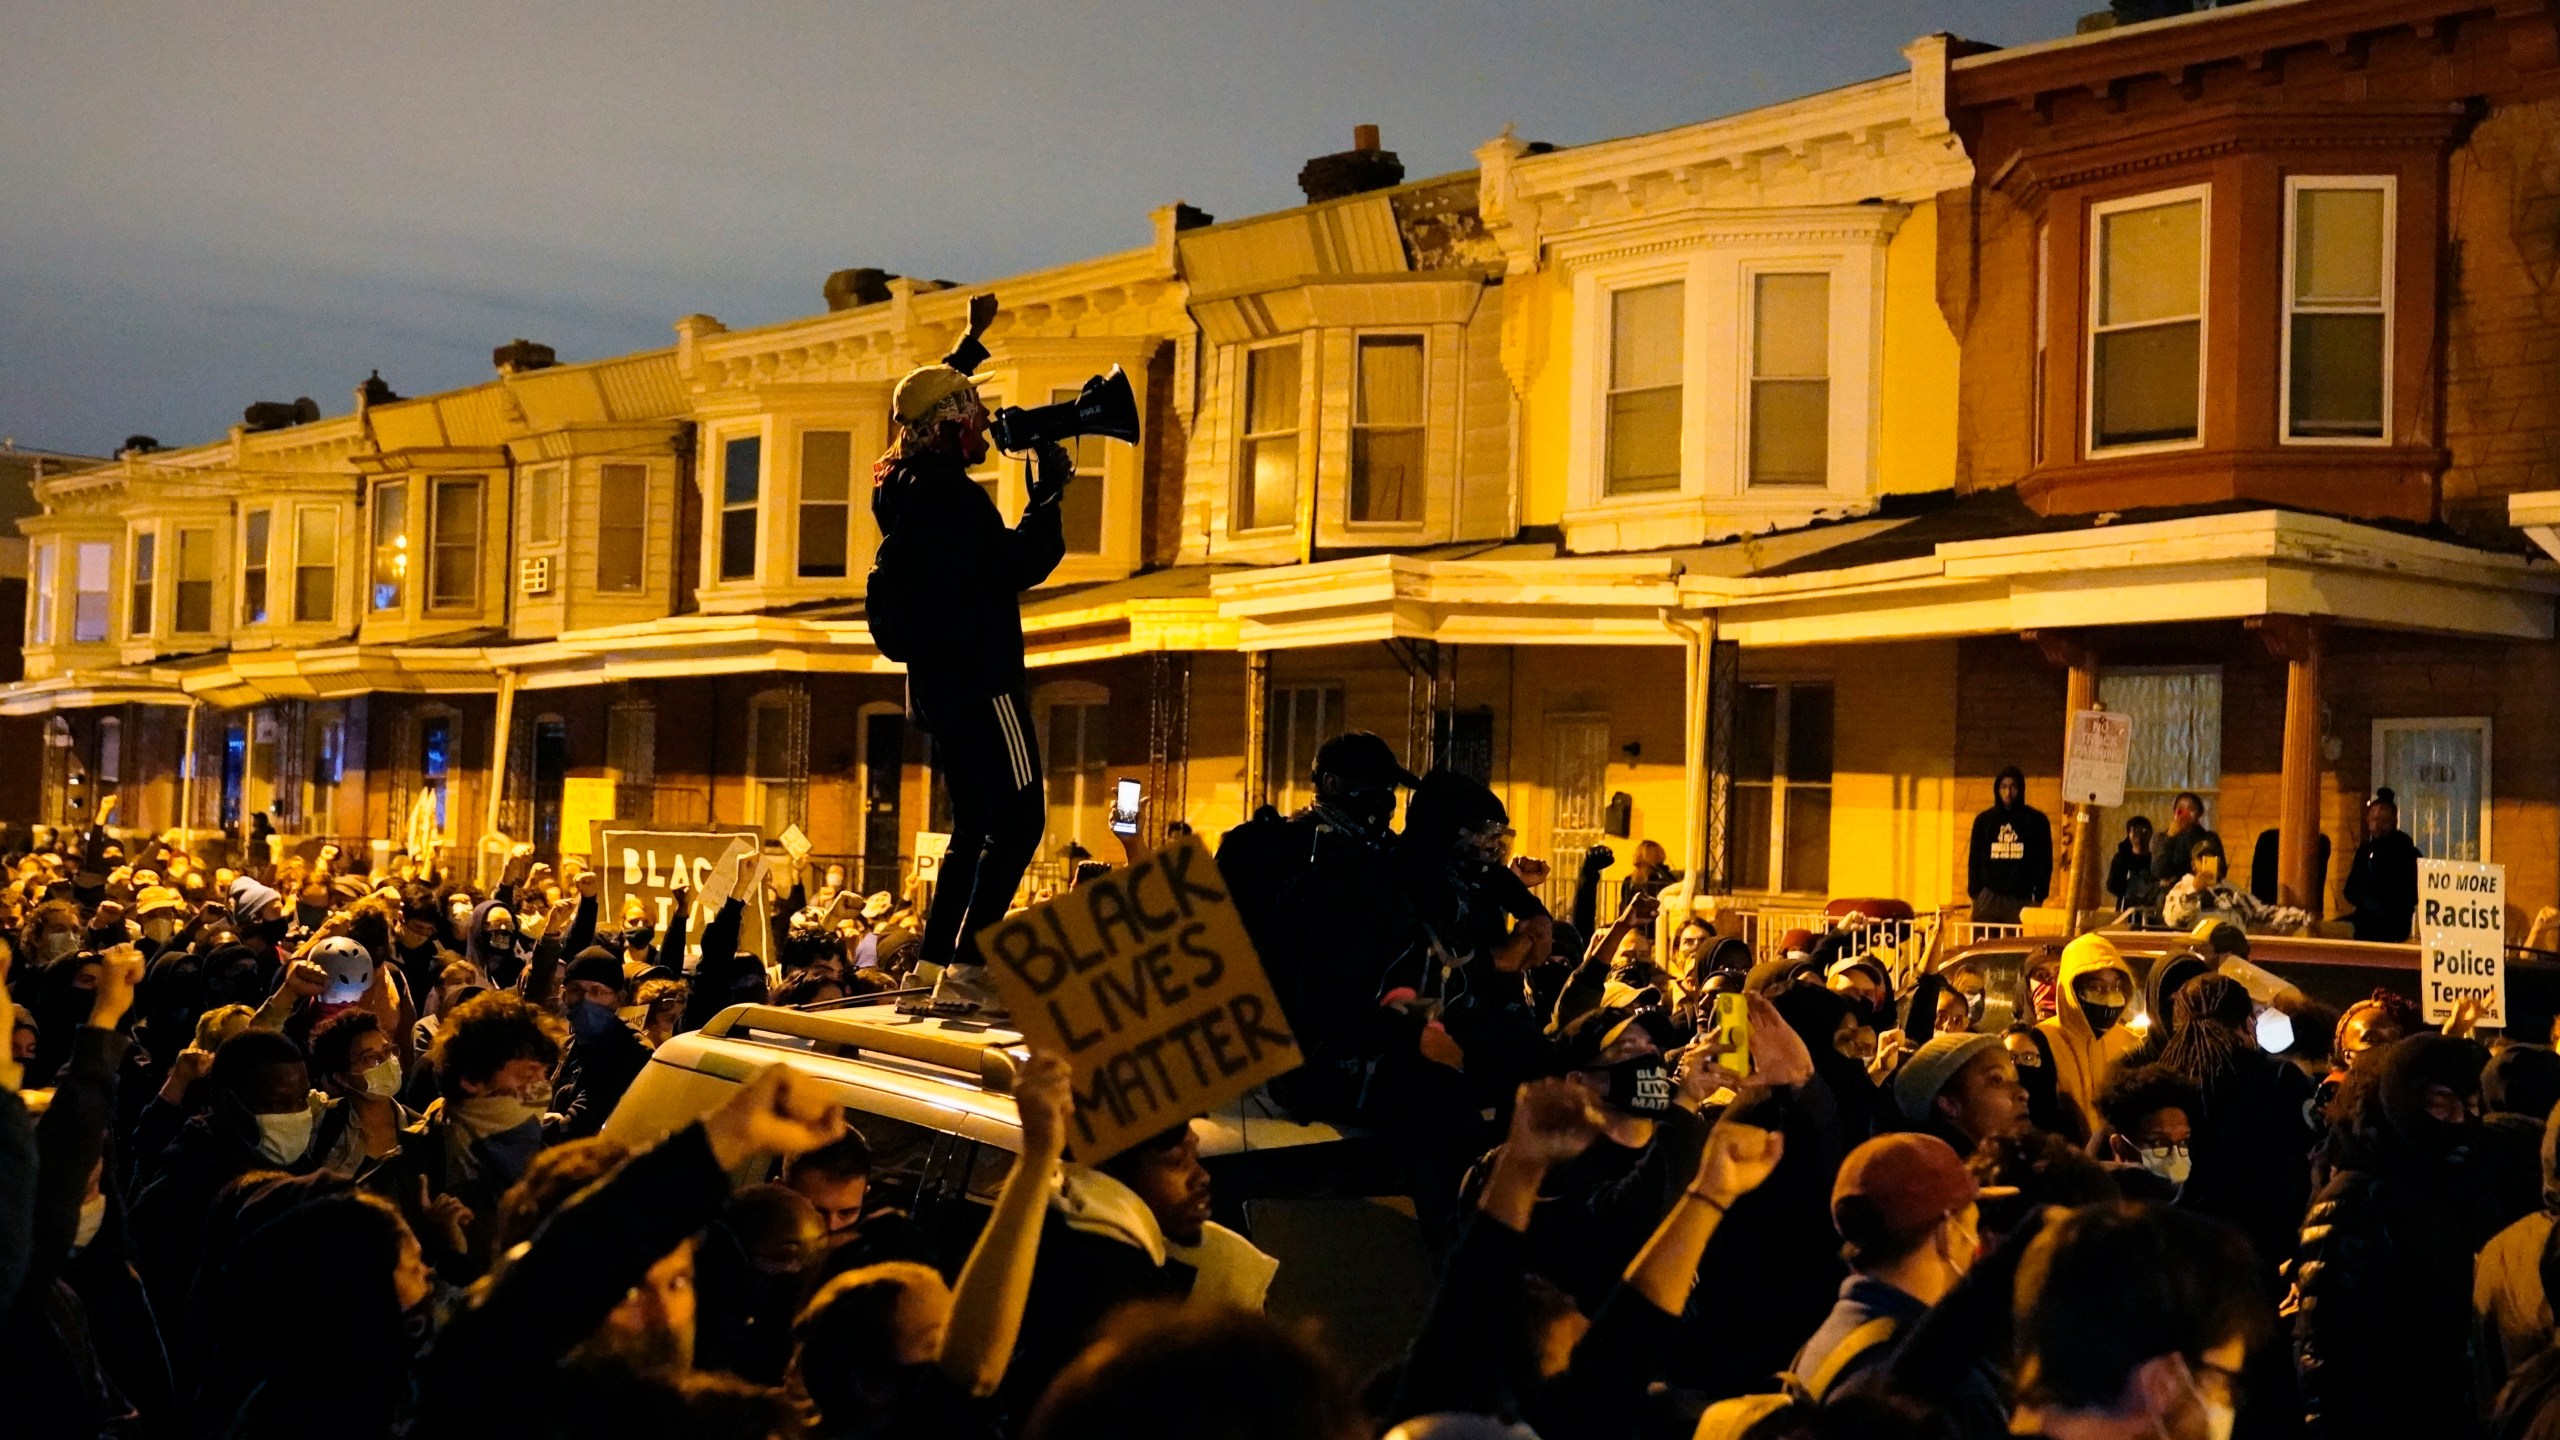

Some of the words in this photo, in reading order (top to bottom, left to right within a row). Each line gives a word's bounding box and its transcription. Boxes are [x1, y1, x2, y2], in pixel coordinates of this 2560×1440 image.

[623, 847, 713, 893] BLAC
[2427, 872, 2450, 889] NO
[2456, 875, 2497, 893] MORE
[993, 844, 1228, 997] BLACK
[2425, 898, 2500, 930] Racist
[1046, 921, 1225, 1050] LIVES
[2433, 950, 2495, 976] Police
[1072, 993, 1295, 1144] MATTER
